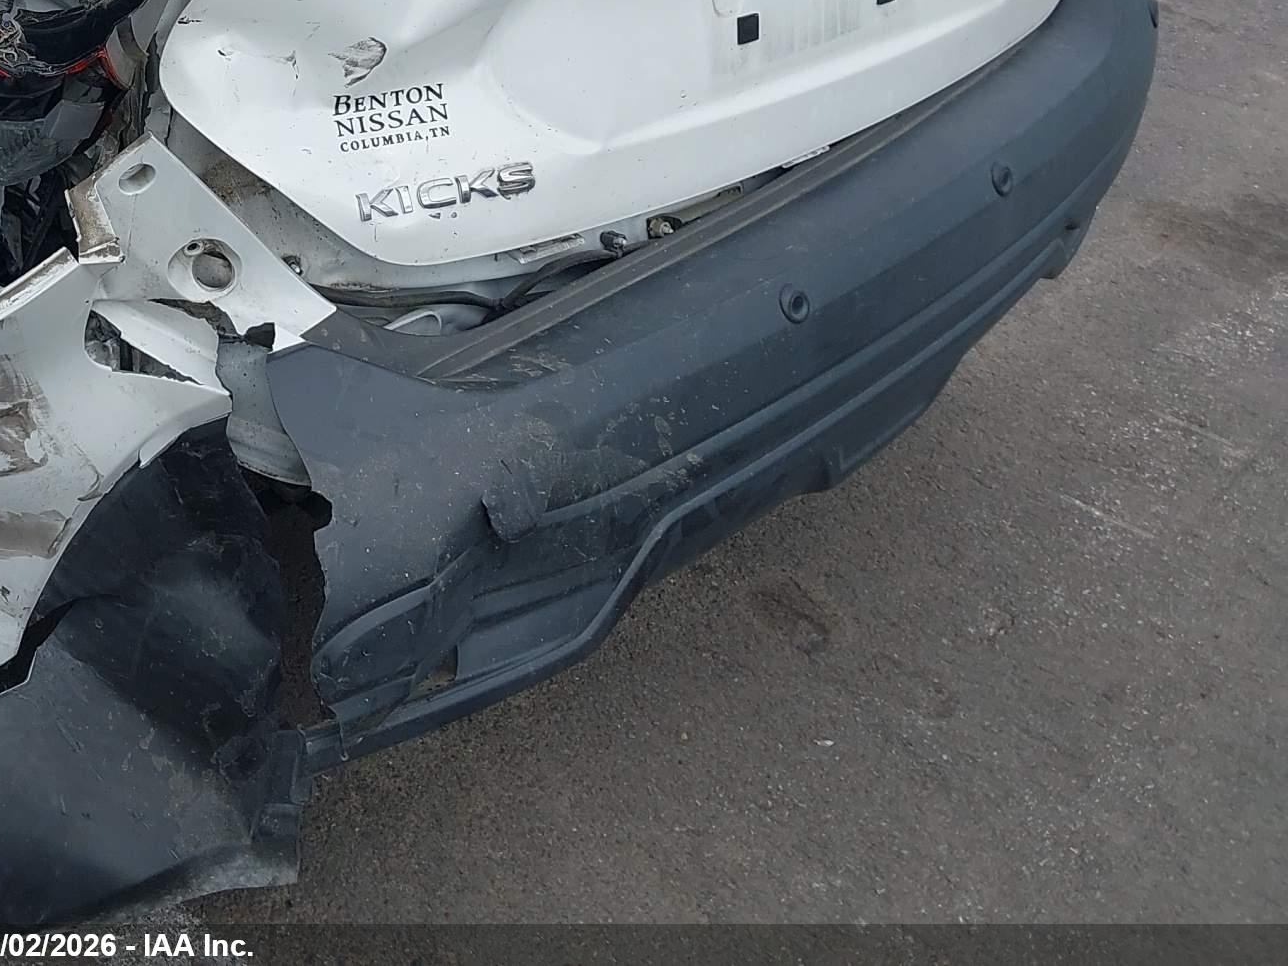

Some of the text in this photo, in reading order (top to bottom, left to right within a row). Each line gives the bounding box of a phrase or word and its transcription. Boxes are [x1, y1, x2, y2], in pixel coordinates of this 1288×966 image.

[332, 83, 444, 117] BENTON
[336, 103, 450, 138] NISSAN
[354, 161, 537, 223] KICKS
